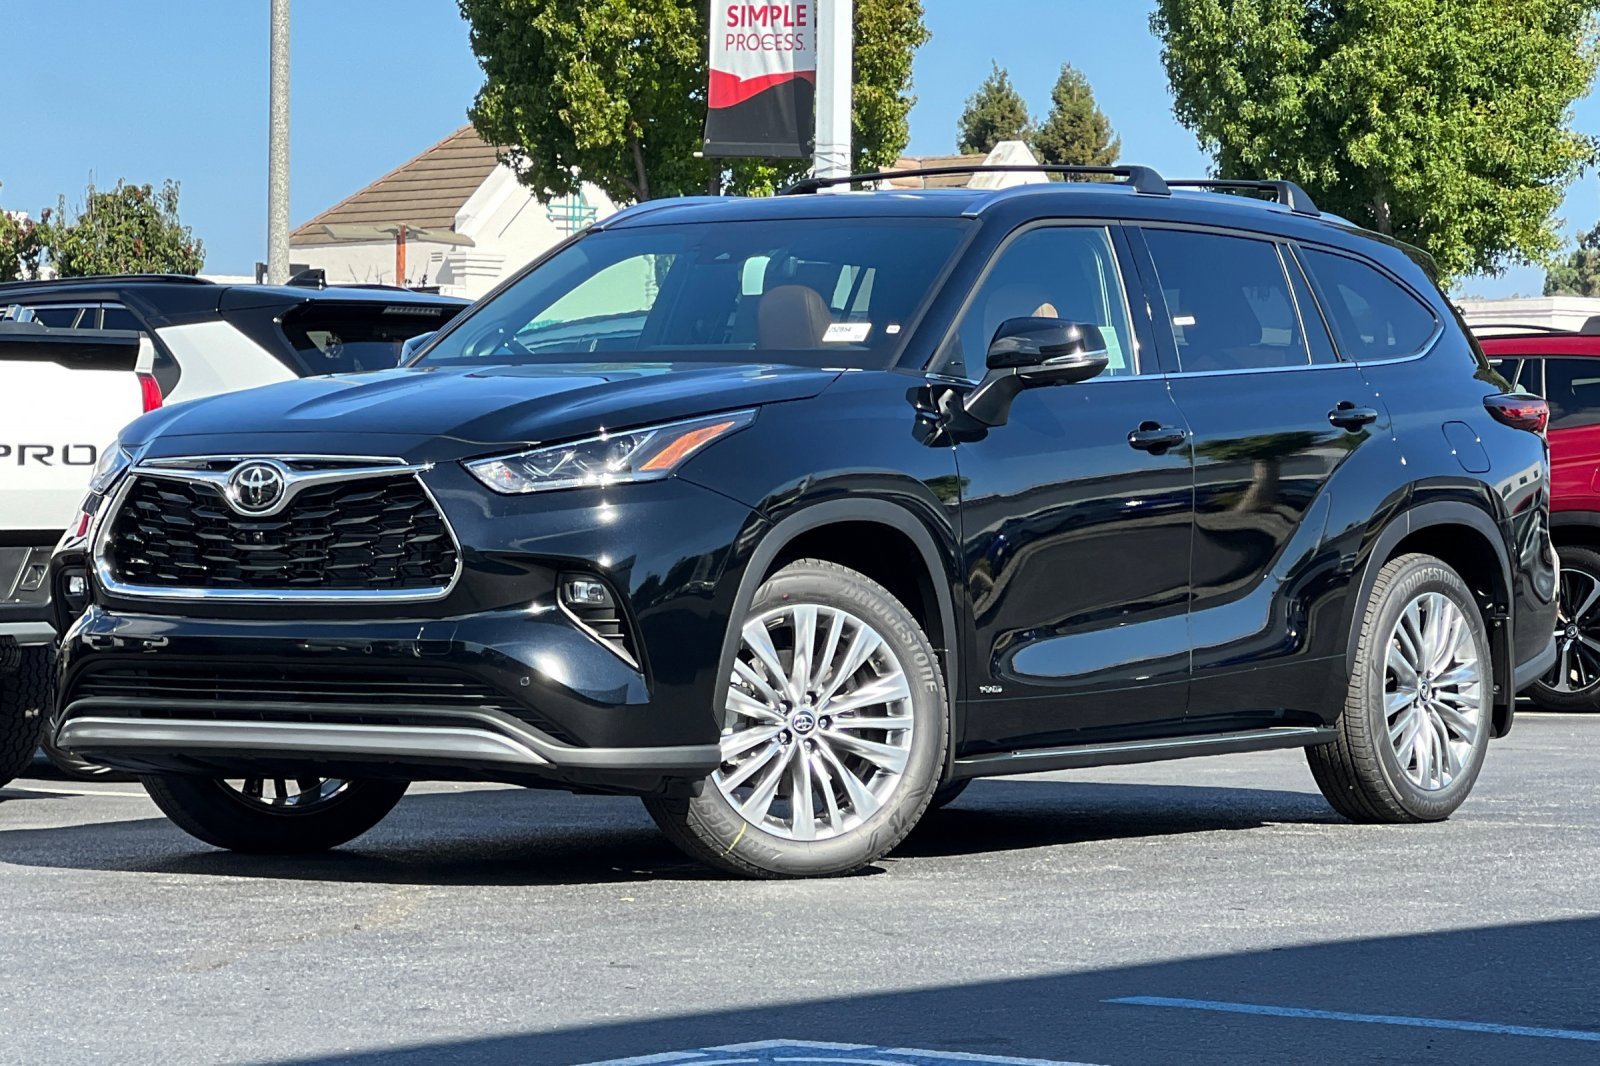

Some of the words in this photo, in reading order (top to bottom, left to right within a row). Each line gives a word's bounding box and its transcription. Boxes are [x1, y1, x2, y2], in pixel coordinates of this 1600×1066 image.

[727, 5, 807, 27] SIMPLE
[725, 33, 806, 51] PROCESS.
[1400, 567, 1461, 602] BRIDGESTONE
[841, 580, 938, 694] BRIDGESTONE
